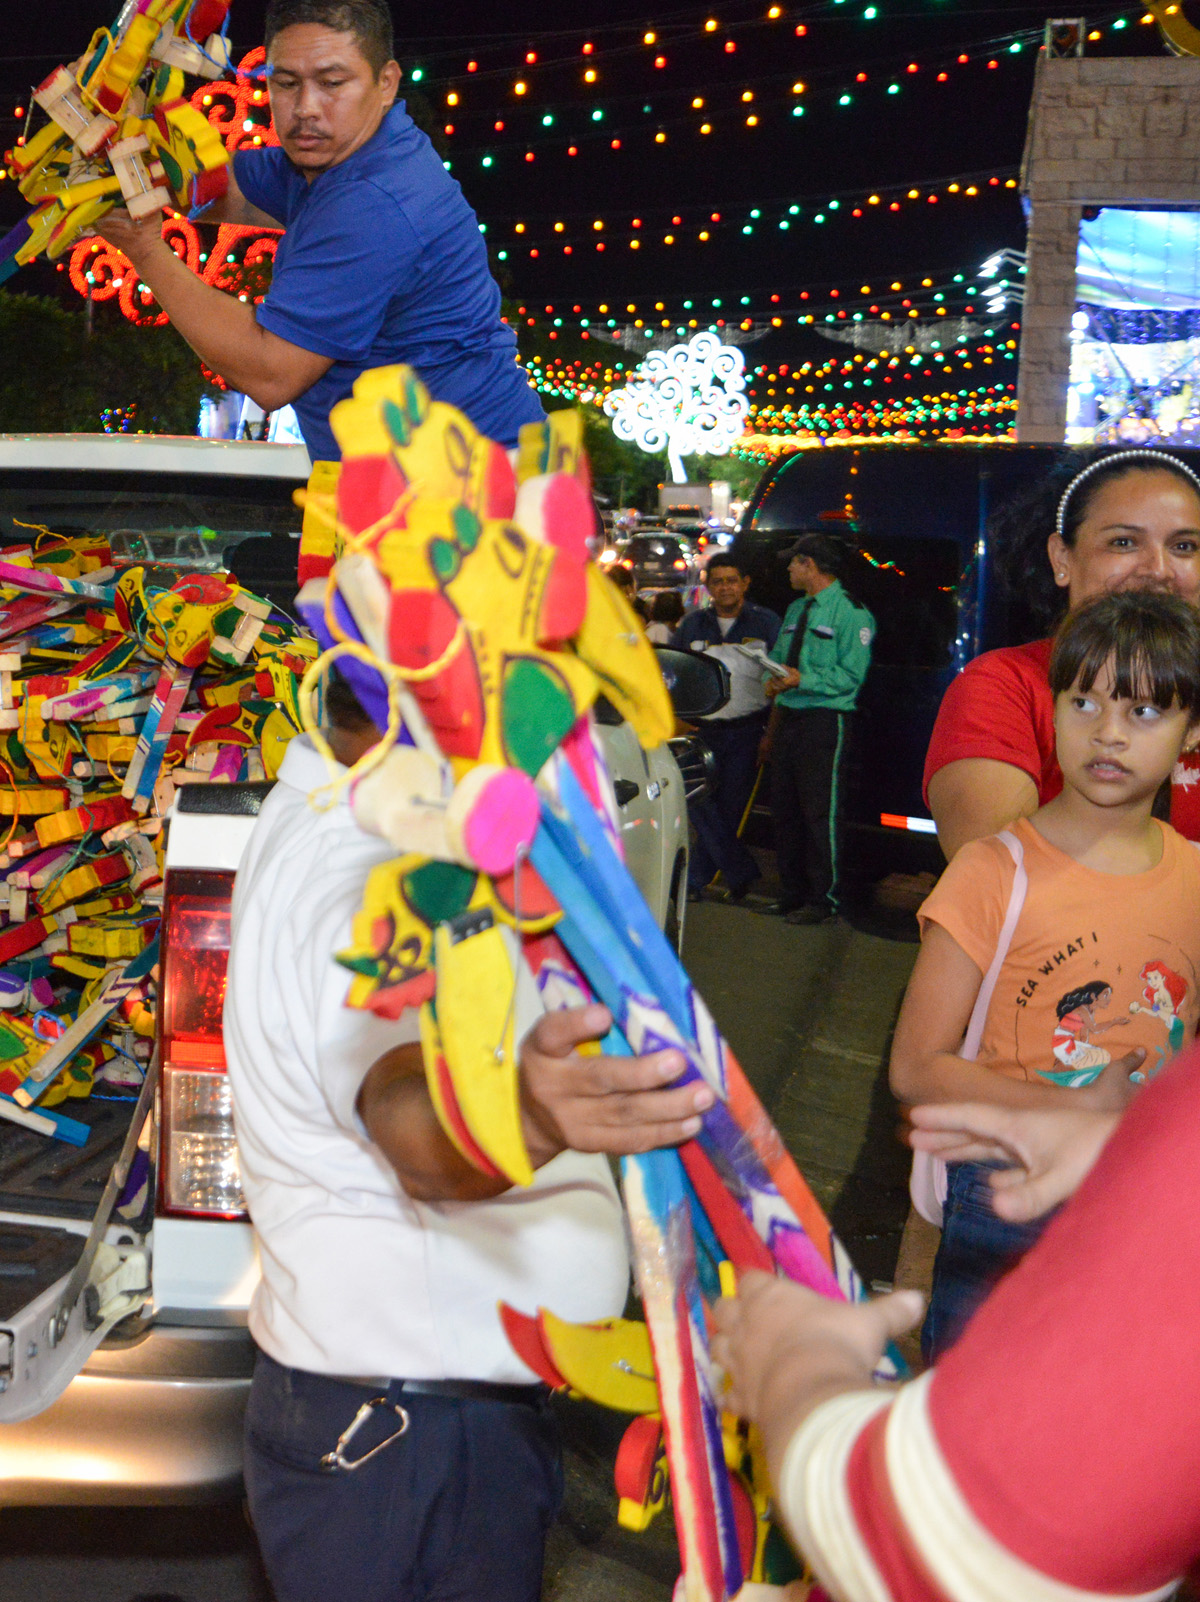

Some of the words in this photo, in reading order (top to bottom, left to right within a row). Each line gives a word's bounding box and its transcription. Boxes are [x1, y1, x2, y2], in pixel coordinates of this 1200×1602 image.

[1015, 979, 1039, 1008] SEA
[1038, 937, 1084, 975] WHAT
[1091, 931, 1098, 943] I
